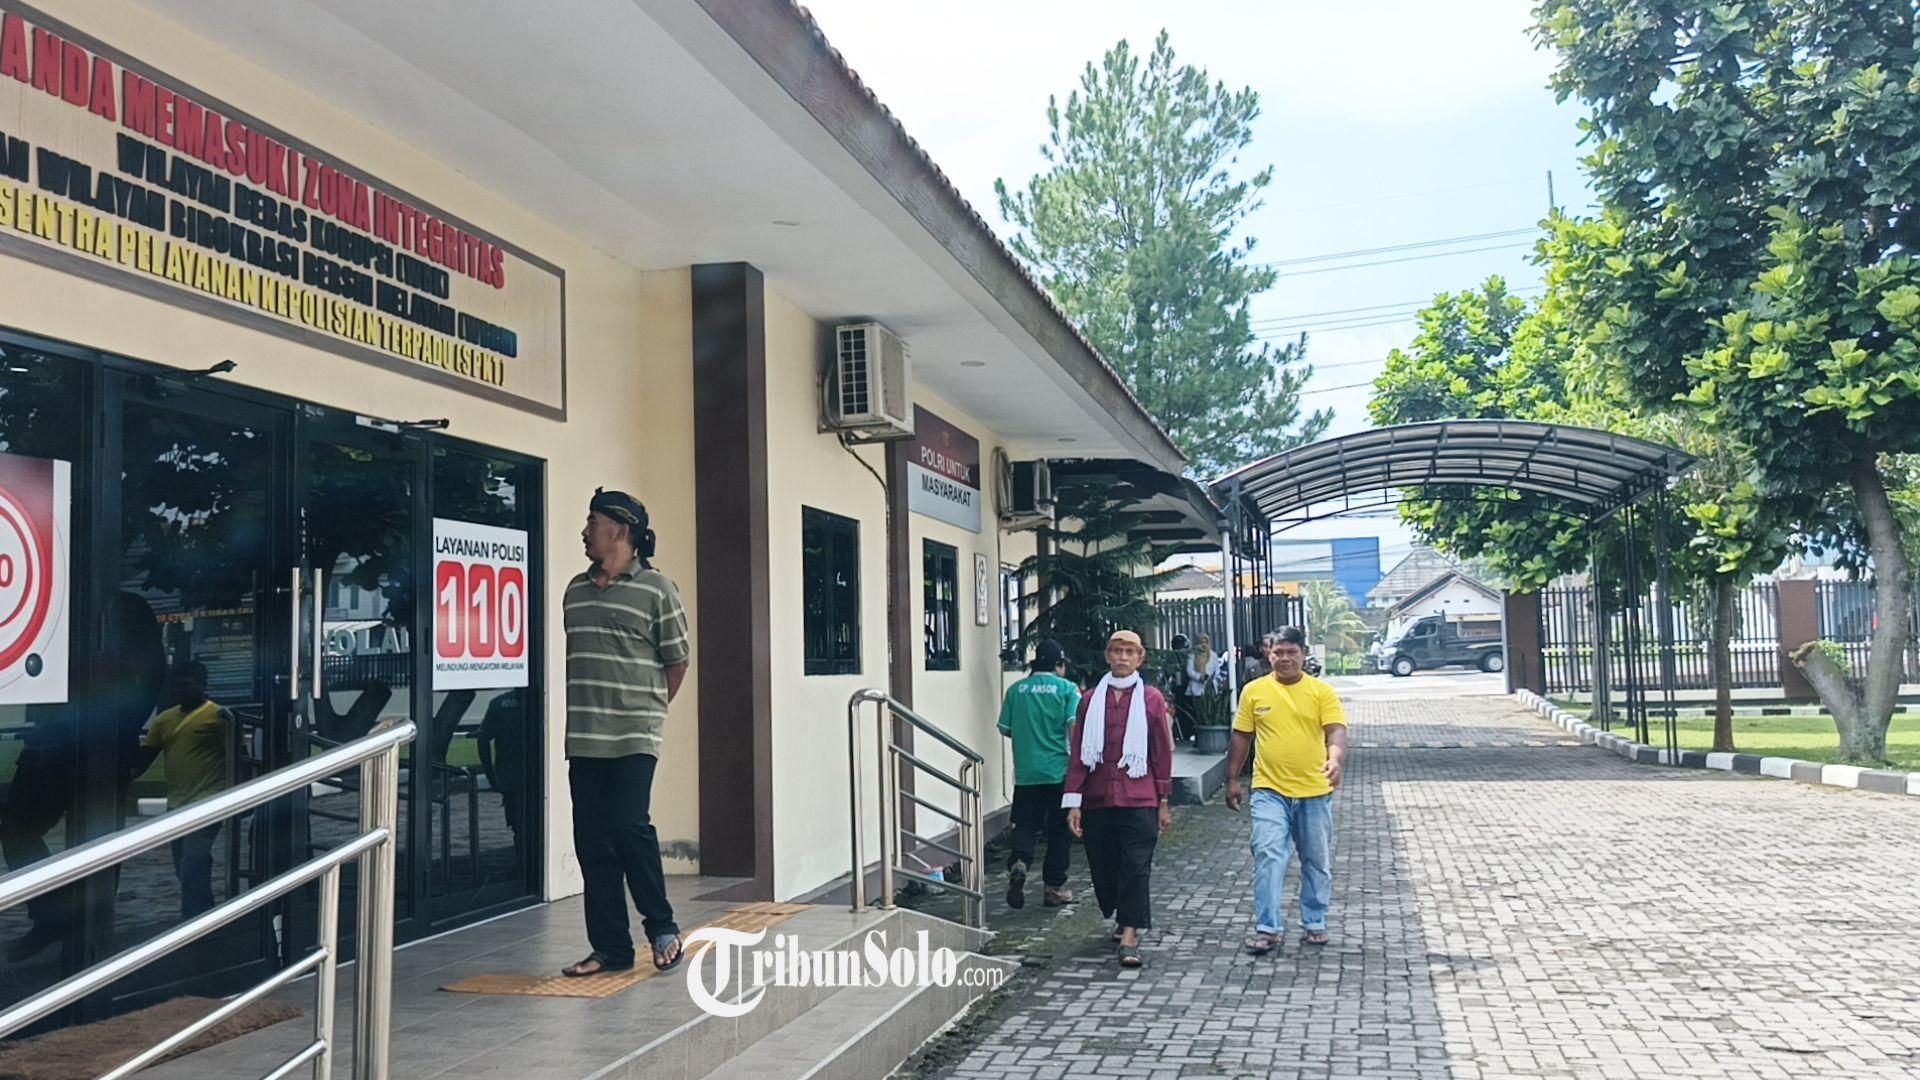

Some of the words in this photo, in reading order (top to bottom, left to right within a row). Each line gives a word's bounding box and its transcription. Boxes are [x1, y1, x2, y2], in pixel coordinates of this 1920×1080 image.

[0, 12, 117, 122] ANDA
[122, 69, 300, 201] MEMASUKI
[302, 155, 371, 233] ZONA
[373, 190, 505, 289] INTEGRITAS
[36, 146, 166, 231] WILAYAH
[170, 199, 299, 280] BIROKRASI
[116, 132, 231, 214] WILAYAH
[234, 182, 308, 243] BEBAS
[310, 215, 394, 278] KORUPSI
[0, 180, 115, 260] SENTRA
[117, 223, 255, 305] PELAYANAN
[259, 274, 379, 346] KEPOLISIAN
[378, 316, 451, 371] TERPADU
[921, 445, 946, 472] POLRI
[946, 457, 971, 483] UNTUK
[922, 473, 971, 507] MASYARAKAT
[436, 536, 489, 559] LAYANAN
[491, 542, 524, 563] POLISI
[439, 573, 522, 648] 110
